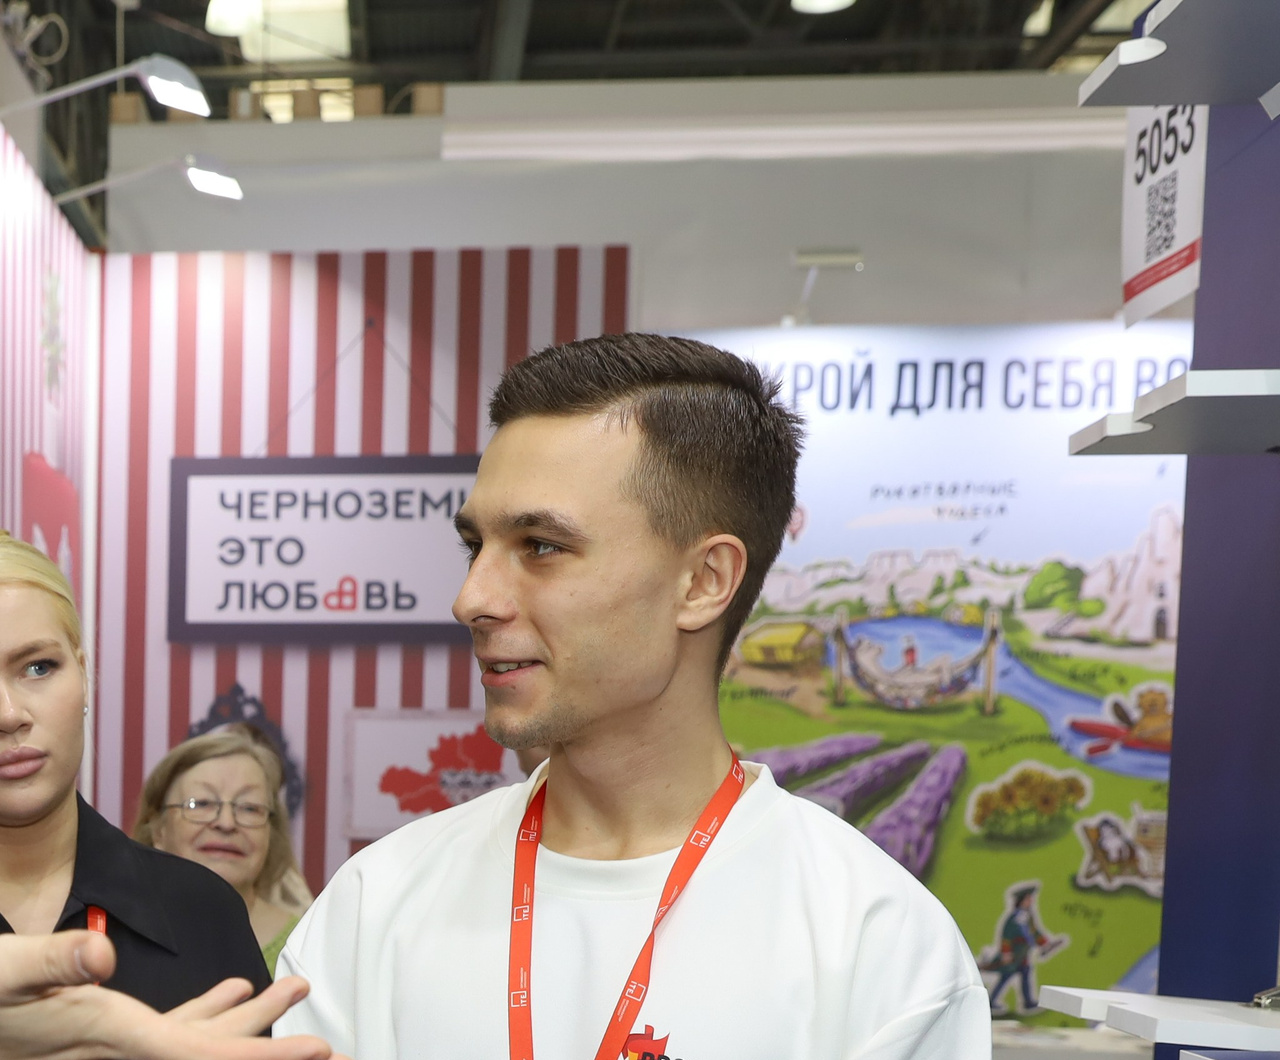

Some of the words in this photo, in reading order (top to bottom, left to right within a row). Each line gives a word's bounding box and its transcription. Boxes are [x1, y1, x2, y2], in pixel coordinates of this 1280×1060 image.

[1134, 104, 1196, 186] 5053
[889, 360, 986, 416] ДЛЯ
[1003, 359, 1115, 410] СЕБЯ
[218, 536, 306, 567] ЭТО
